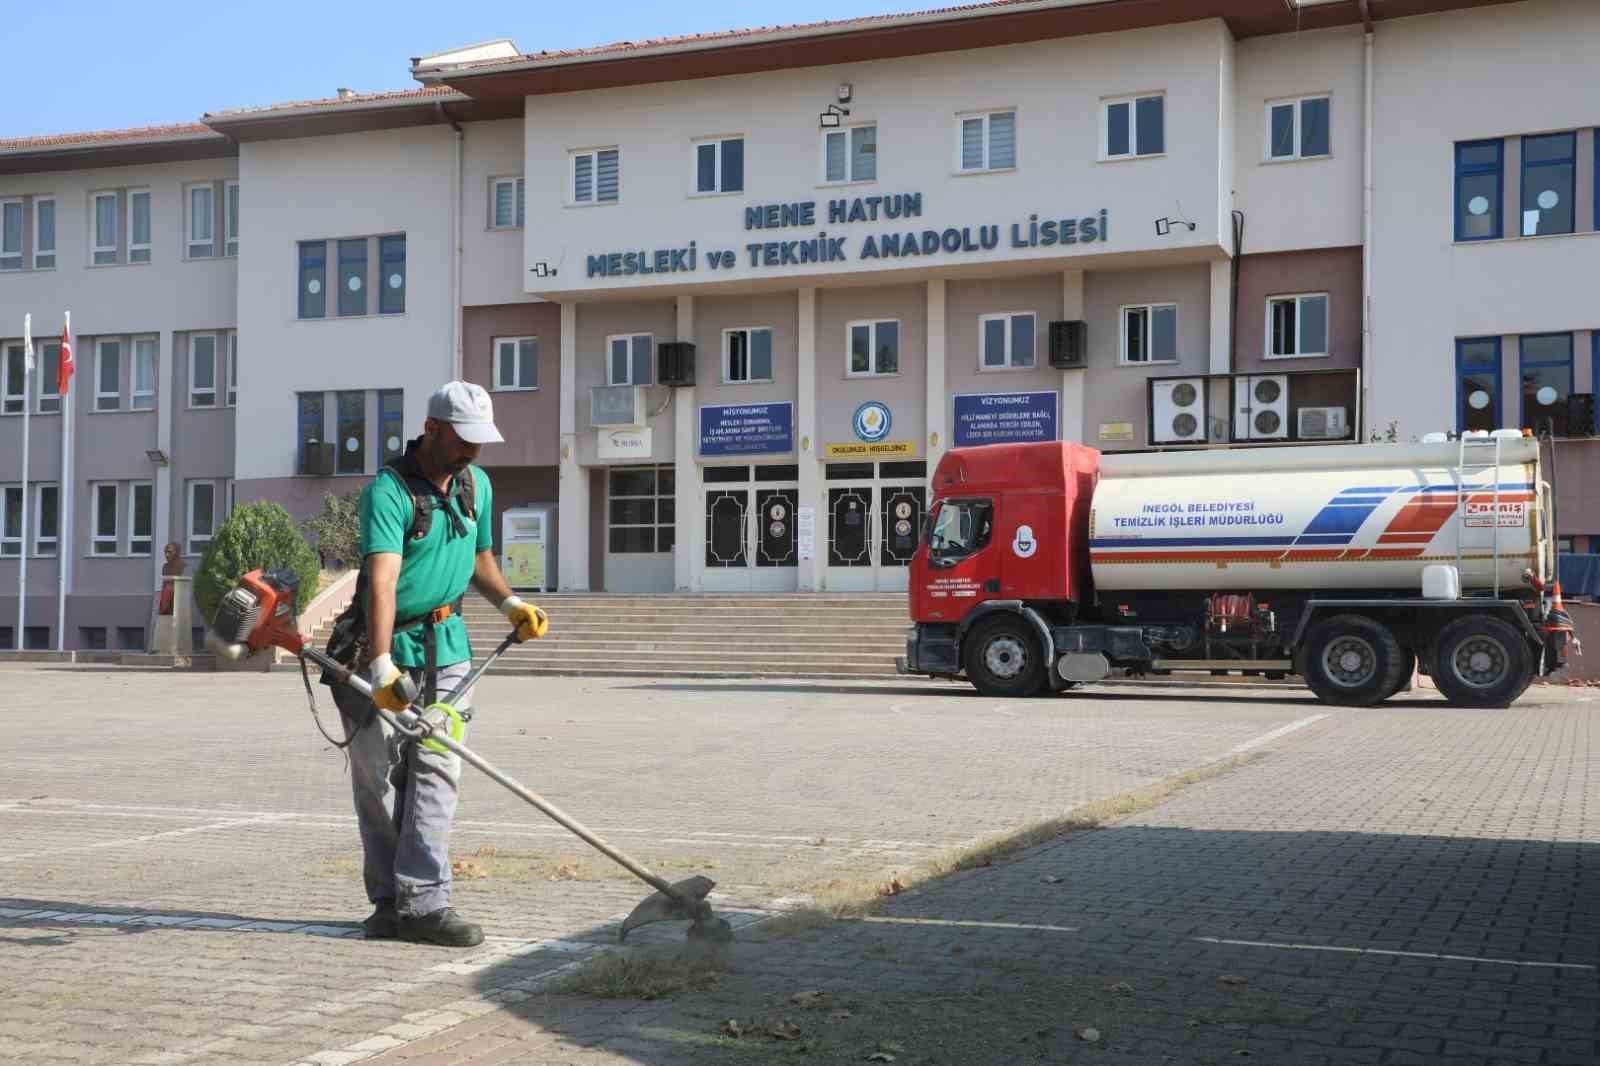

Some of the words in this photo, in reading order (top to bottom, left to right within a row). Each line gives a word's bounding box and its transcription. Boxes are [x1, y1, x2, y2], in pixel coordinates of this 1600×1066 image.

[744, 200, 816, 231] NENE
[828, 192, 923, 223] HATUN
[586, 240, 697, 278] MESLEKİ
[707, 250, 737, 270] ve
[747, 231, 847, 268] TEKNİK
[860, 224, 999, 260] ANADOLU
[1011, 208, 1109, 247] LİSESİ
[1113, 516, 1165, 528] TEMİZLİK
[1169, 514, 1206, 528] İŞLERİ
[1209, 511, 1285, 526] MÜDÜRLÜĞÜ
[1142, 503, 1185, 514] İNEGÖL
[1187, 501, 1255, 513] BELEDİYESİ
